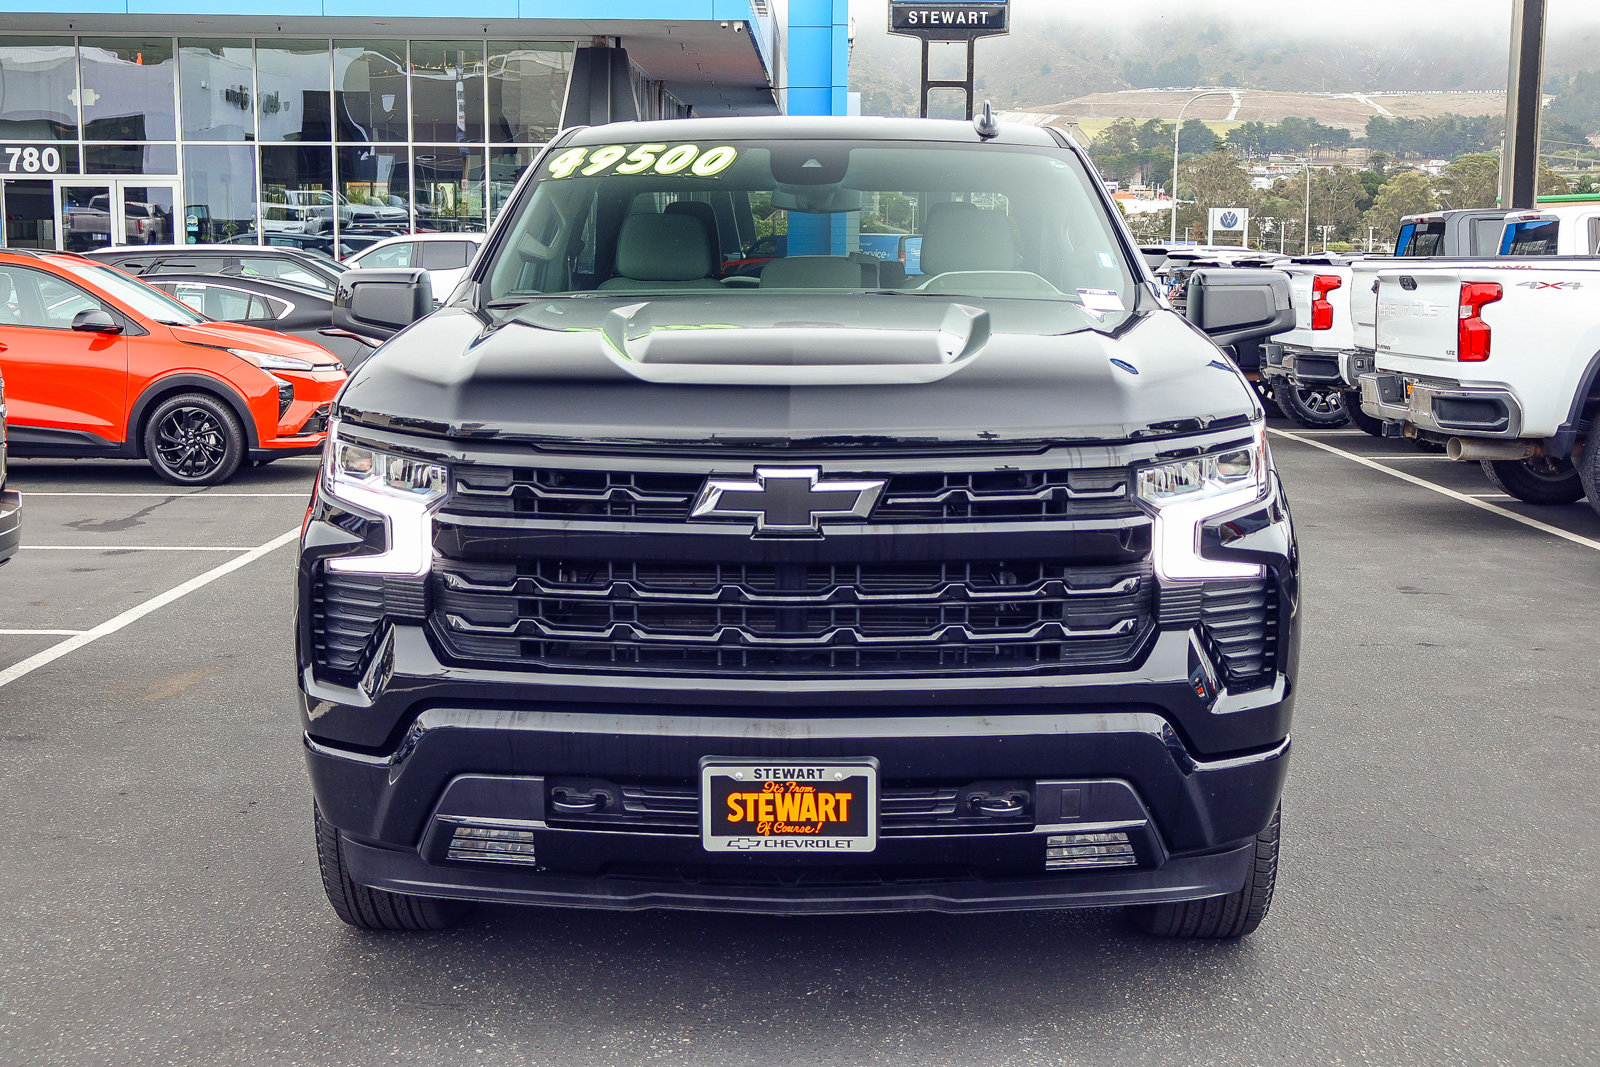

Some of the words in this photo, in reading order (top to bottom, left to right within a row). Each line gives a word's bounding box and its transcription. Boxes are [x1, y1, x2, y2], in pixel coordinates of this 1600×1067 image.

[908, 11, 989, 24] STEWART
[5, 147, 60, 172] 780
[548, 144, 738, 179] 49500
[753, 768, 825, 780] STEWART
[762, 781, 785, 793] It's
[786, 781, 816, 793] From
[726, 792, 852, 822] STEWART
[757, 821, 772, 836] Of
[764, 840, 853, 848] CHEVROLET
